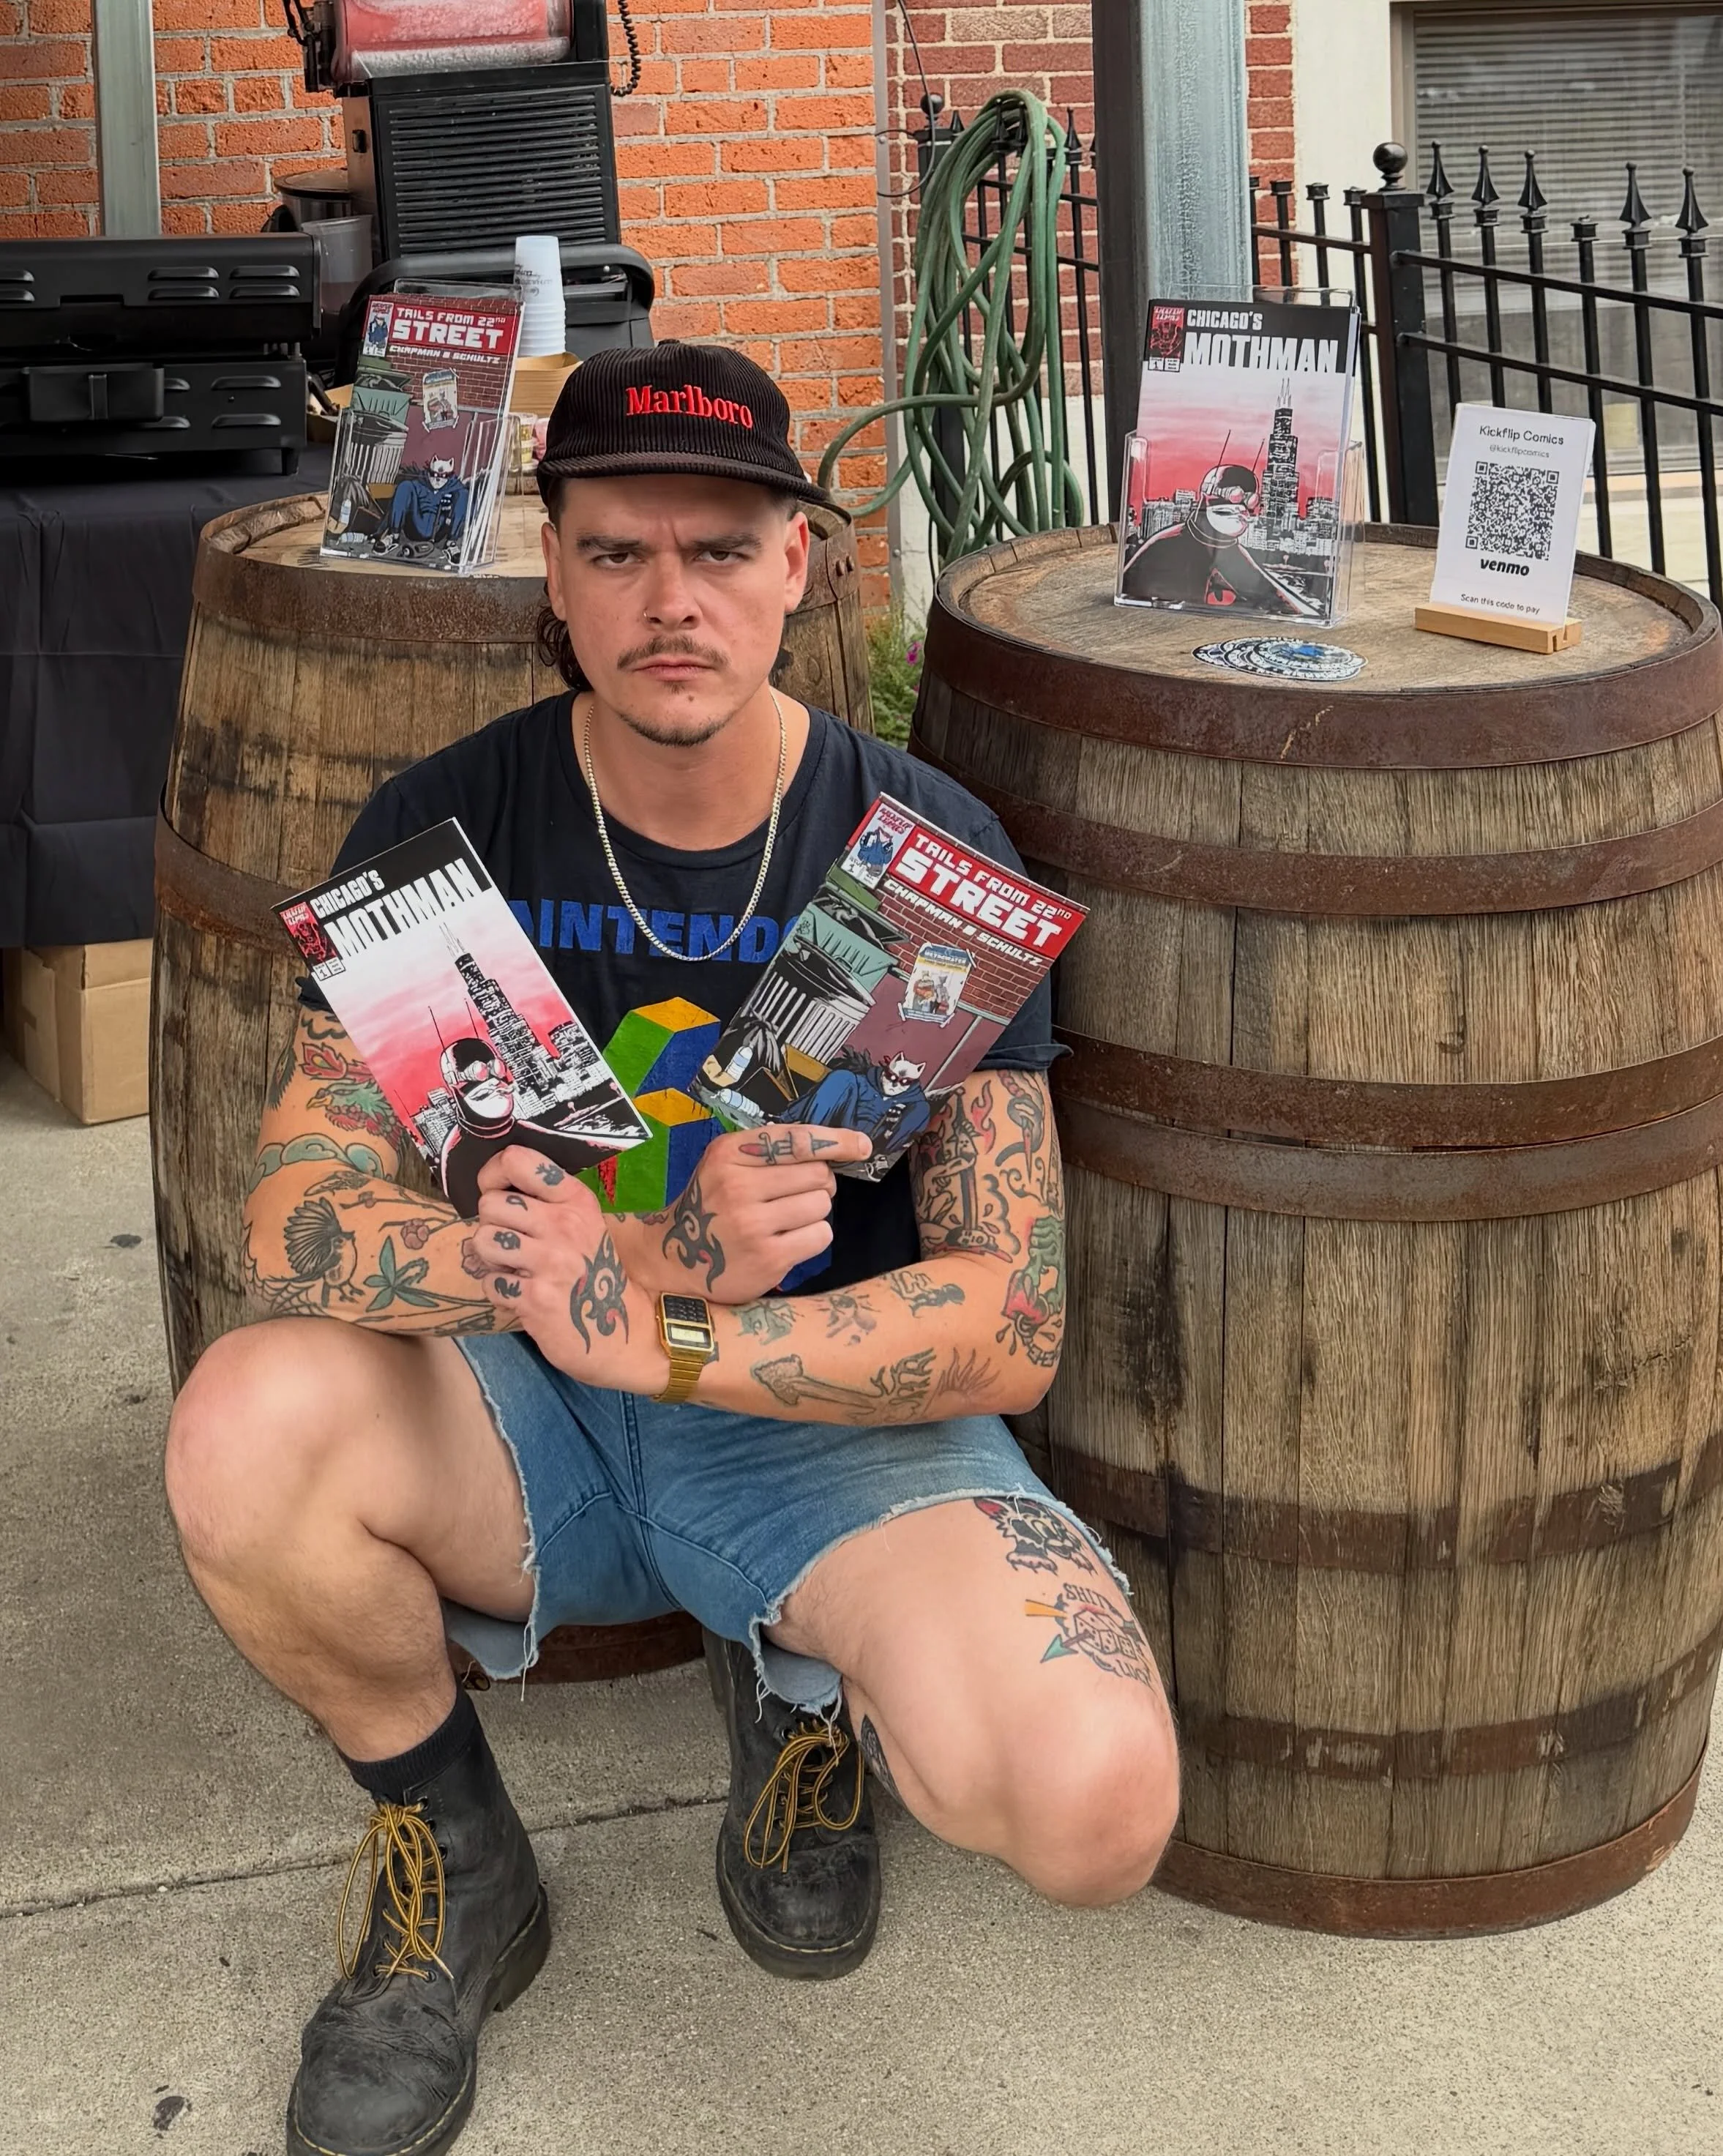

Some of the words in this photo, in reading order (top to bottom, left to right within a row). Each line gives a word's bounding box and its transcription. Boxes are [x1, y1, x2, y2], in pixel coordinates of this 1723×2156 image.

[397, 307, 434, 321] TAILS
[437, 312, 474, 325] FROM
[1186, 308, 1263, 331] CHICAGO'S
[392, 319, 504, 349] STREET
[389, 345, 441, 358] CHAPMAN
[452, 353, 501, 365] SCHULTZ
[1184, 331, 1339, 373] MOTHMAN
[626, 384, 754, 429] Marlboro
[1479, 425, 1520, 441] Kickflip
[1523, 430, 1564, 445] Comics
[1490, 444, 1550, 458] @kickflipcomics
[1480, 559, 1530, 576] venmo
[1460, 594, 1479, 603] Scan
[1481, 597, 1494, 606] this
[1495, 600, 1515, 610] code
[1525, 606, 1541, 615] pay
[915, 833, 973, 877] TAILS
[973, 870, 1031, 907] FROM
[310, 870, 386, 920] CHICAGO'S
[324, 858, 482, 960] MOTHMAN
[895, 846, 1062, 948] STREET
[883, 879, 962, 930] CHAPMAN
[976, 931, 1044, 967] SCHULTZ
